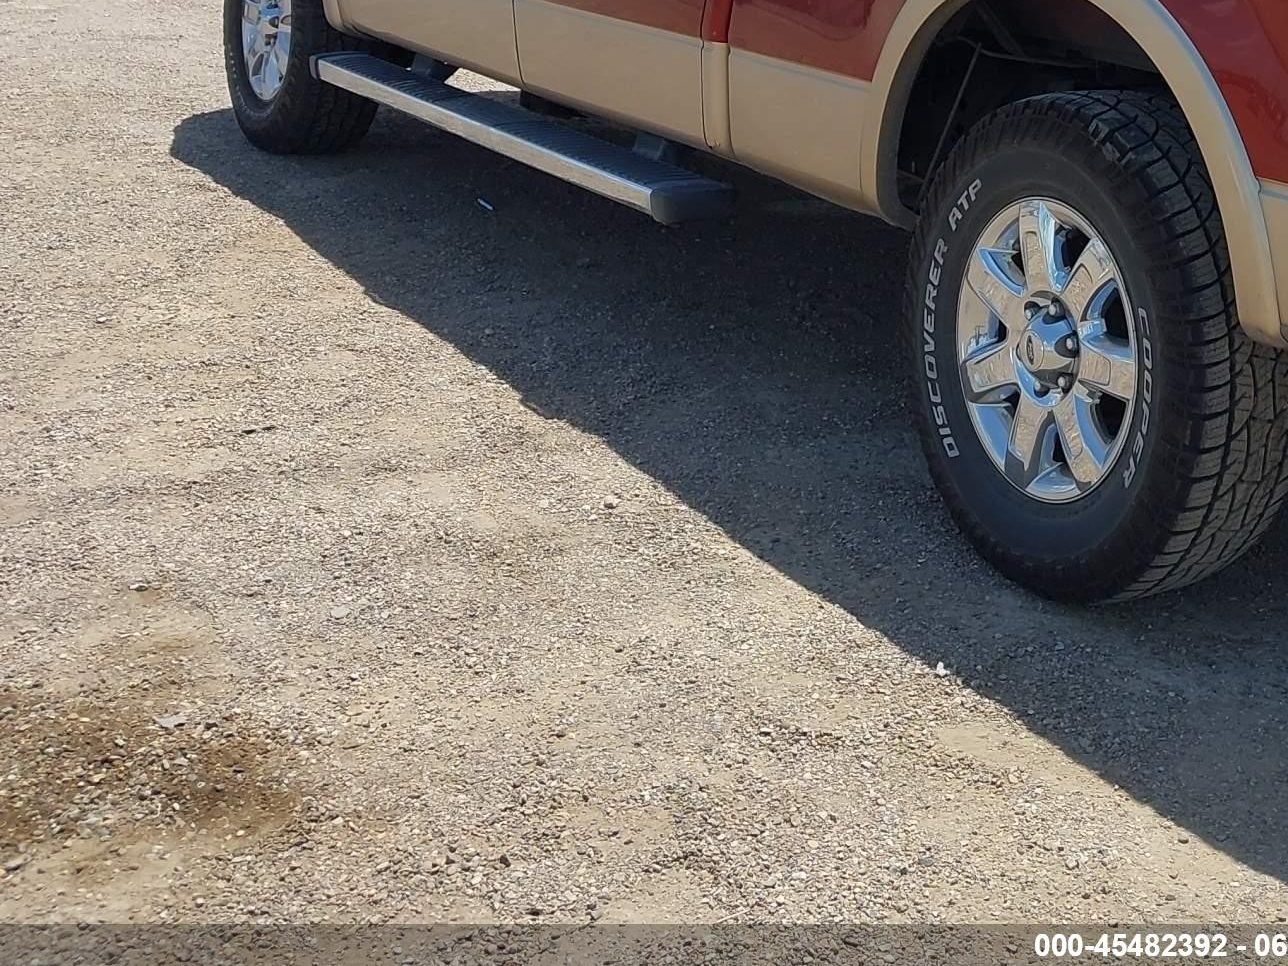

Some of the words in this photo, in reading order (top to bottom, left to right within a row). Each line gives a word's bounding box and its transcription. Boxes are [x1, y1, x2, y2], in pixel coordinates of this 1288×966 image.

[923, 237, 960, 459] DISCOVERER
[948, 178, 983, 232] ATP
[1122, 307, 1153, 489] COOPER
